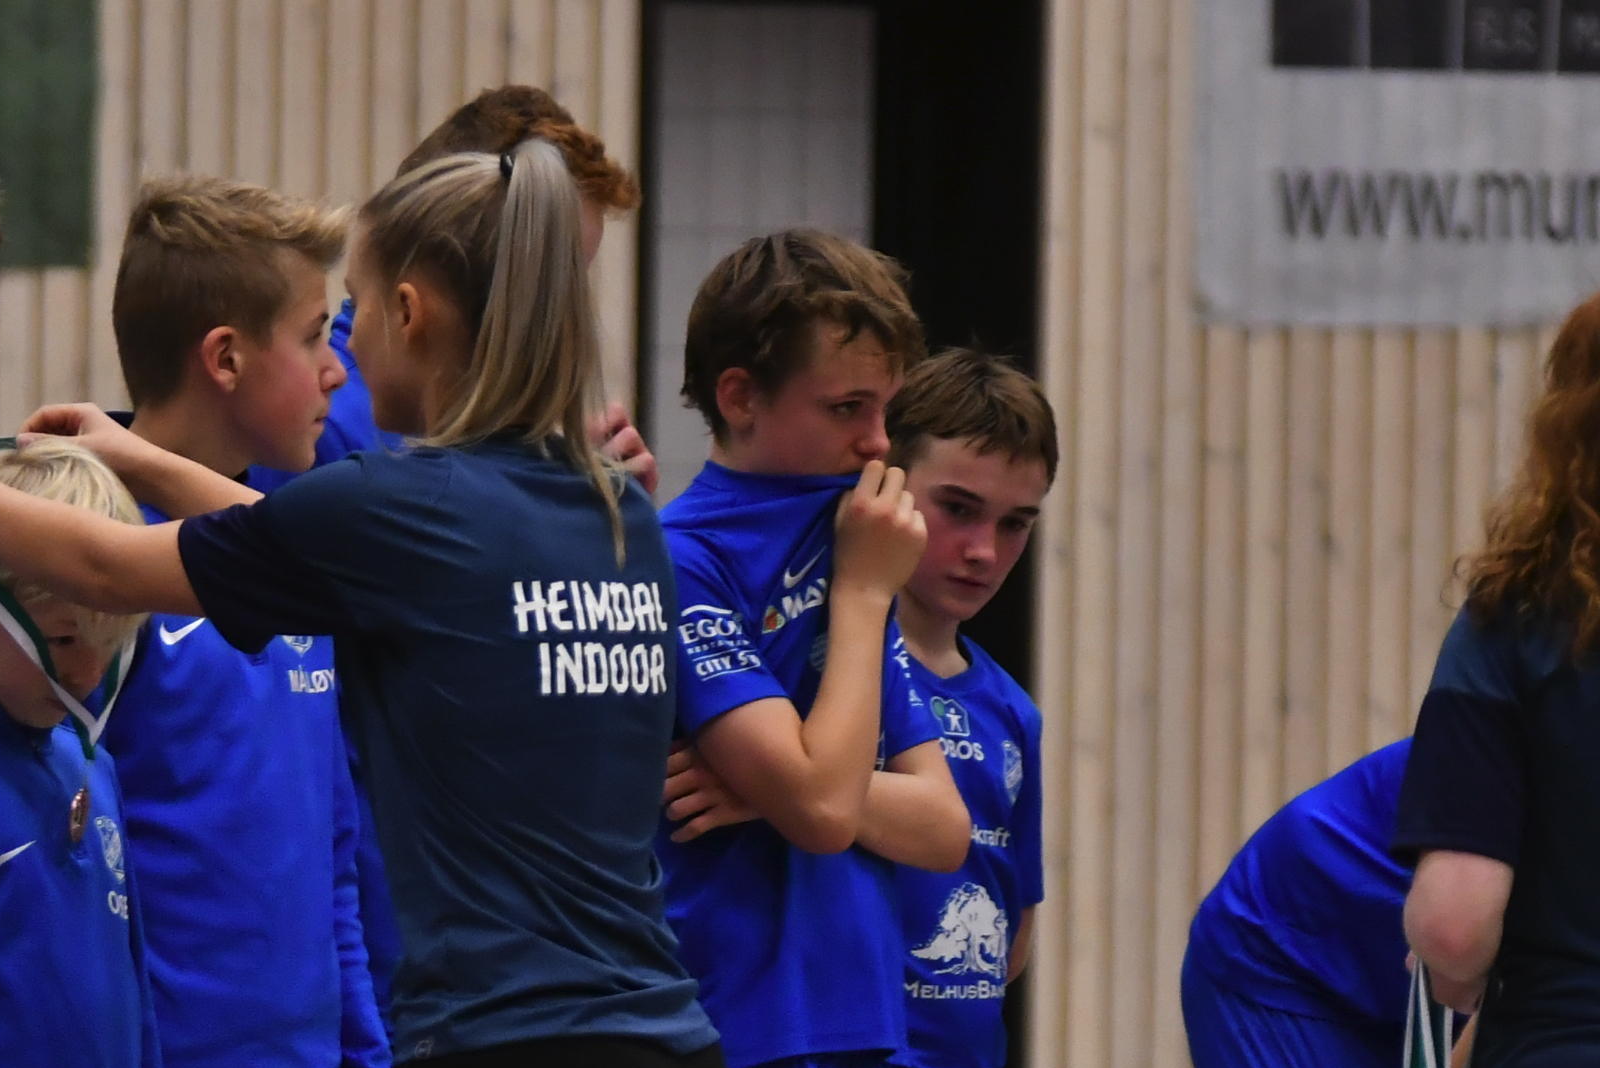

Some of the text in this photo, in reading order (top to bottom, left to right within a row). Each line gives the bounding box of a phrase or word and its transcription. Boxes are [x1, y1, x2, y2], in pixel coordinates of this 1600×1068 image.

[513, 580, 667, 632] HEIMDAL
[539, 642, 667, 694] INDOOR
[696, 655, 732, 676] CITY
